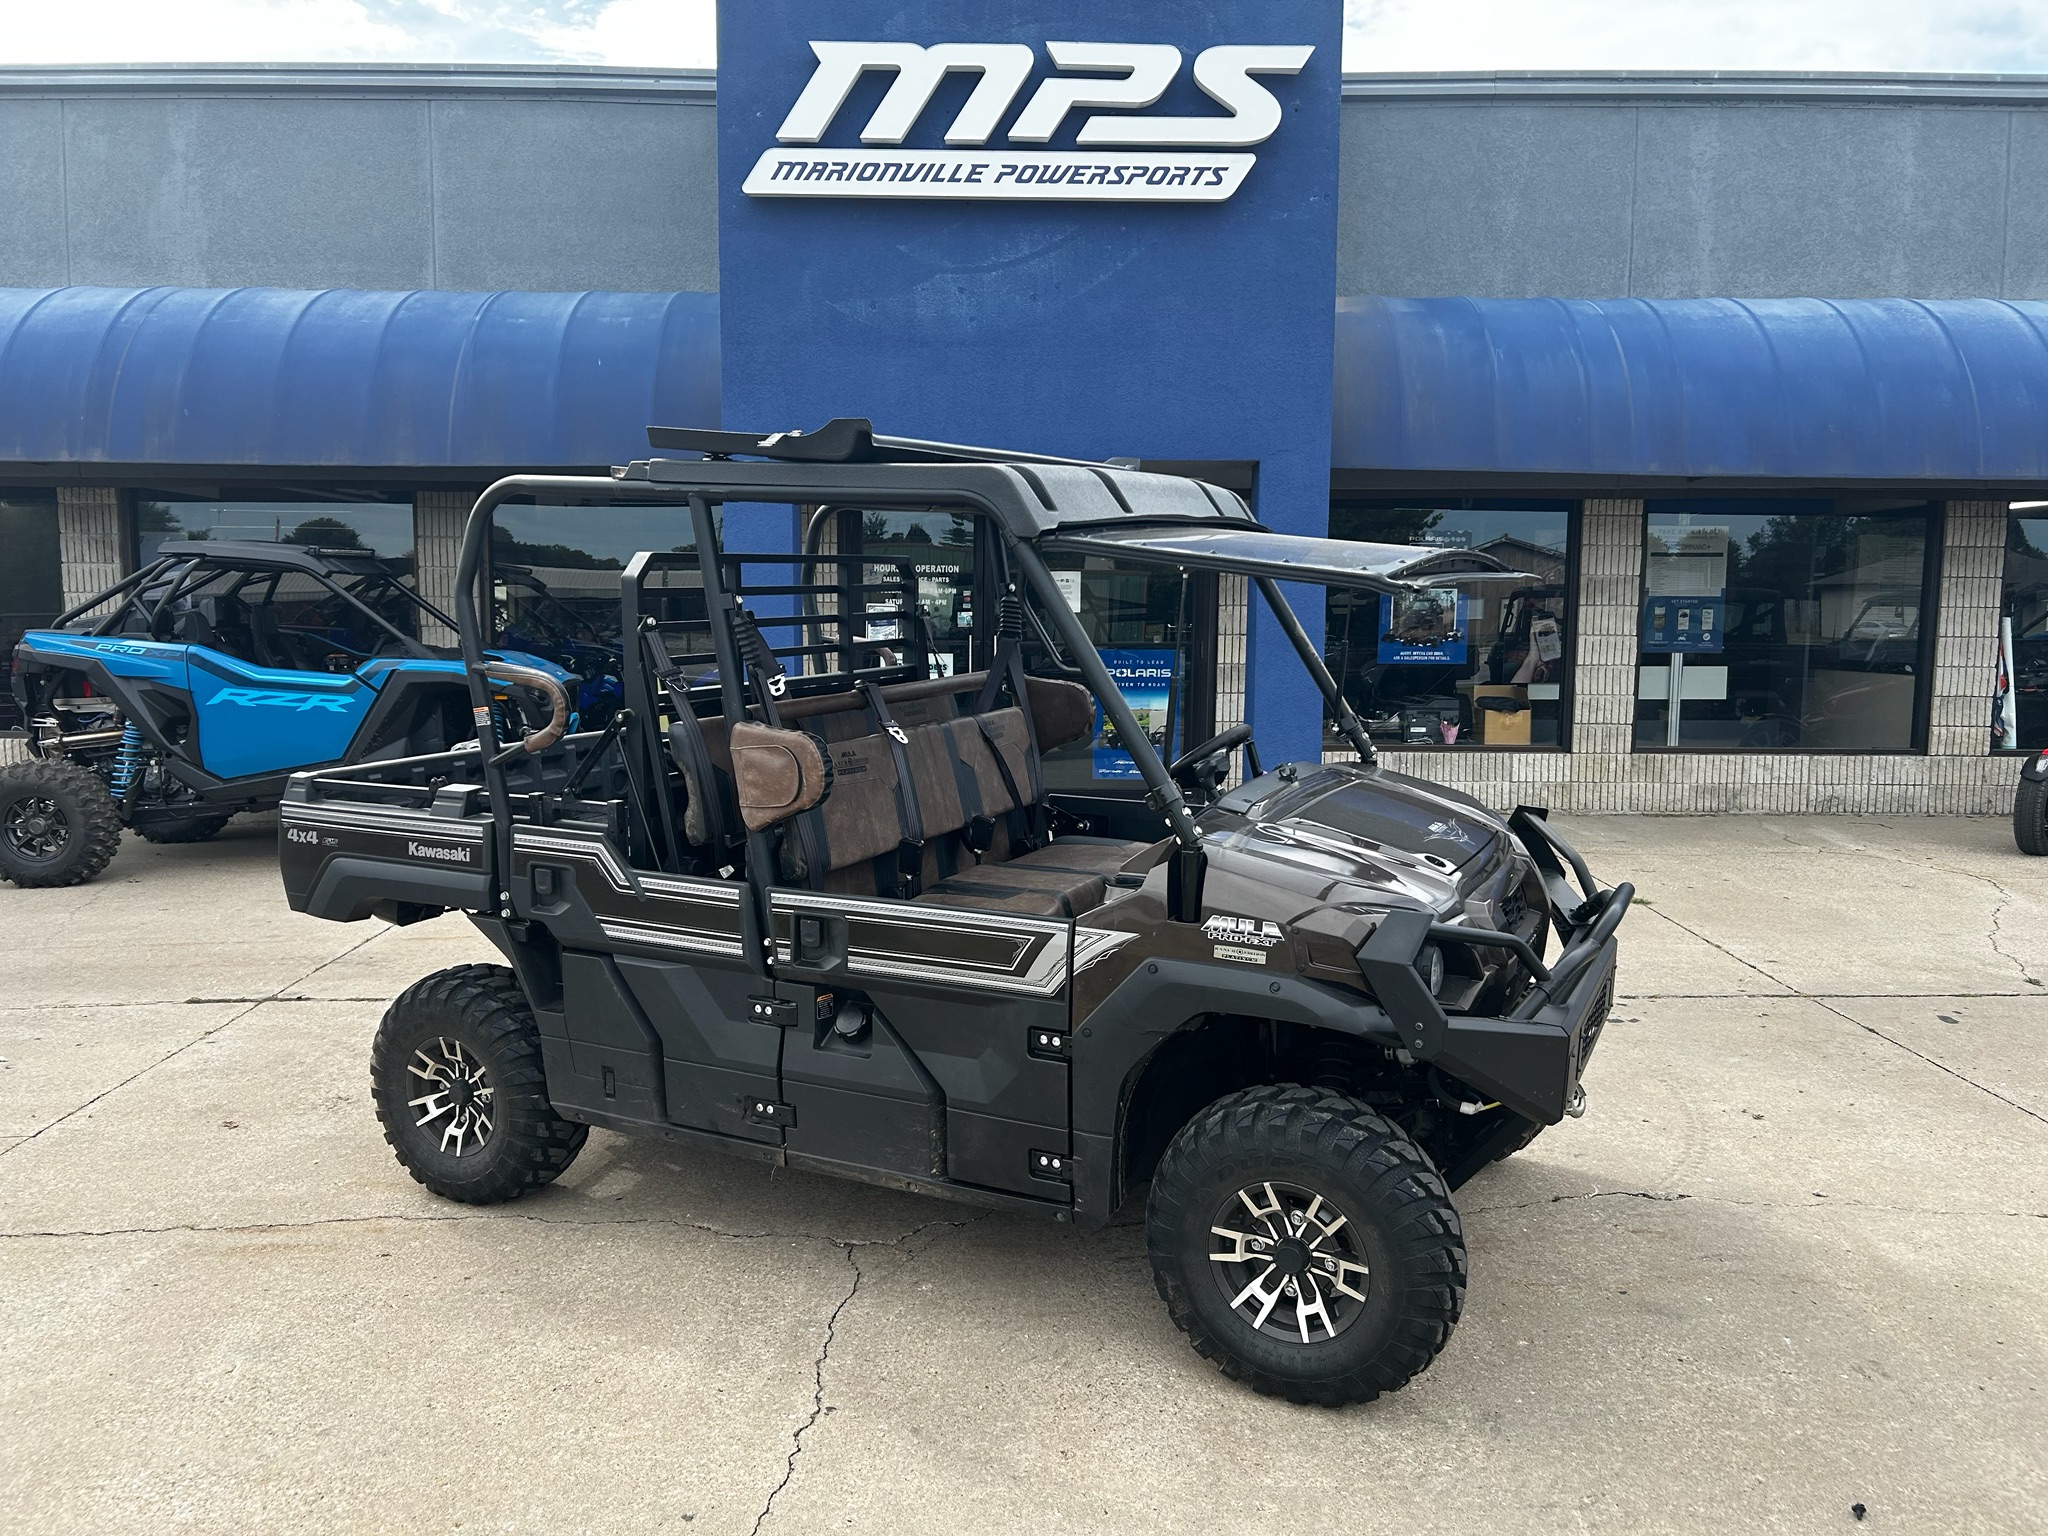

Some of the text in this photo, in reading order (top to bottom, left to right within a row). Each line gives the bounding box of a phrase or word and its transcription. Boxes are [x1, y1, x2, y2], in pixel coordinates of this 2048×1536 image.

[775, 41, 1316, 147] MPS
[769, 161, 1231, 187] MARIONVILLE POWERSPORTS
[915, 565, 960, 573] OPERATION
[94, 643, 183, 657] PRO XP
[1107, 669, 1171, 678] POLARIS
[206, 687, 356, 713] RZR
[287, 828, 319, 845] 4x4
[408, 841, 471, 862] Kawasaki
[1200, 914, 1285, 941] MULE
